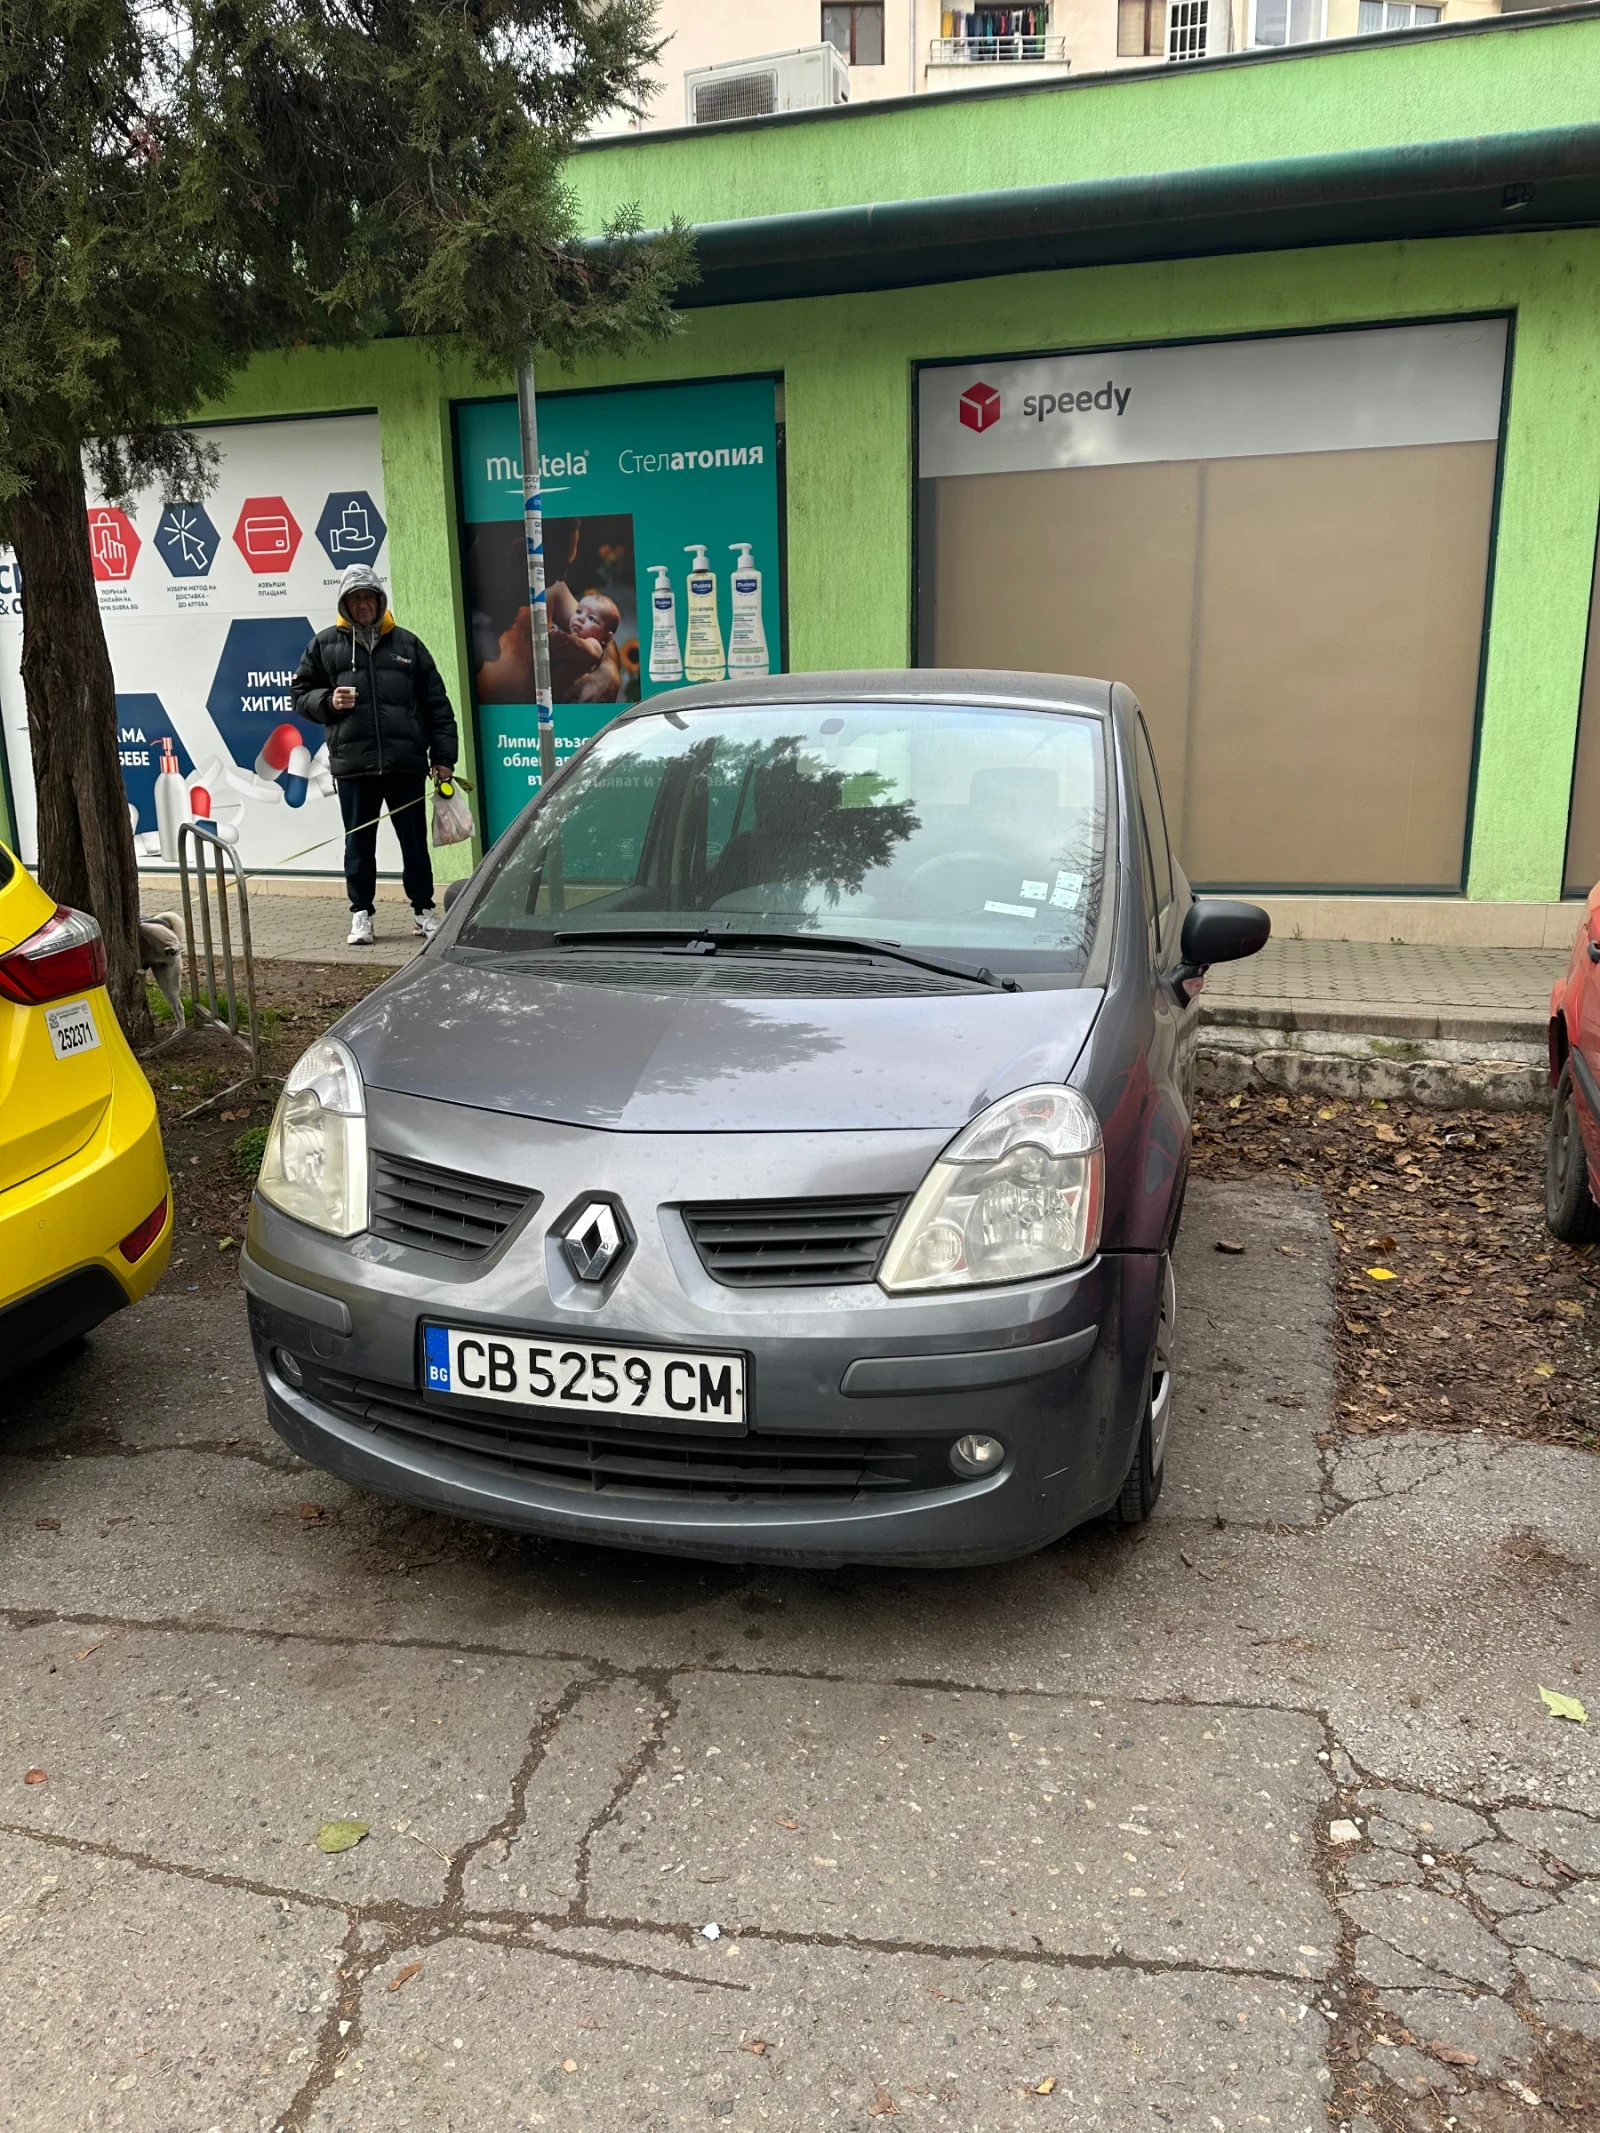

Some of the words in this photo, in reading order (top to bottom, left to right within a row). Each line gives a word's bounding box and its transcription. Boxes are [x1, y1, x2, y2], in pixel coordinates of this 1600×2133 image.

[1023, 381, 1132, 422] speedy
[618, 446, 764, 474] Стелатопия
[101, 586, 127, 595] ПОРЪЧАЙ
[258, 589, 287, 597] ПЛАЩАНЕ
[99, 595, 122, 603] ОНЛАЙН
[100, 603, 139, 611] WW.SUBRA.BG
[247, 671, 293, 687] ЛИЧН
[241, 696, 293, 711] ХИГИЕ
[57, 1021, 93, 1051] 252371
[430, 1365, 448, 1382] BG
[457, 1340, 517, 1393] CB
[529, 1348, 651, 1406] 5259
[664, 1361, 732, 1415] CM
